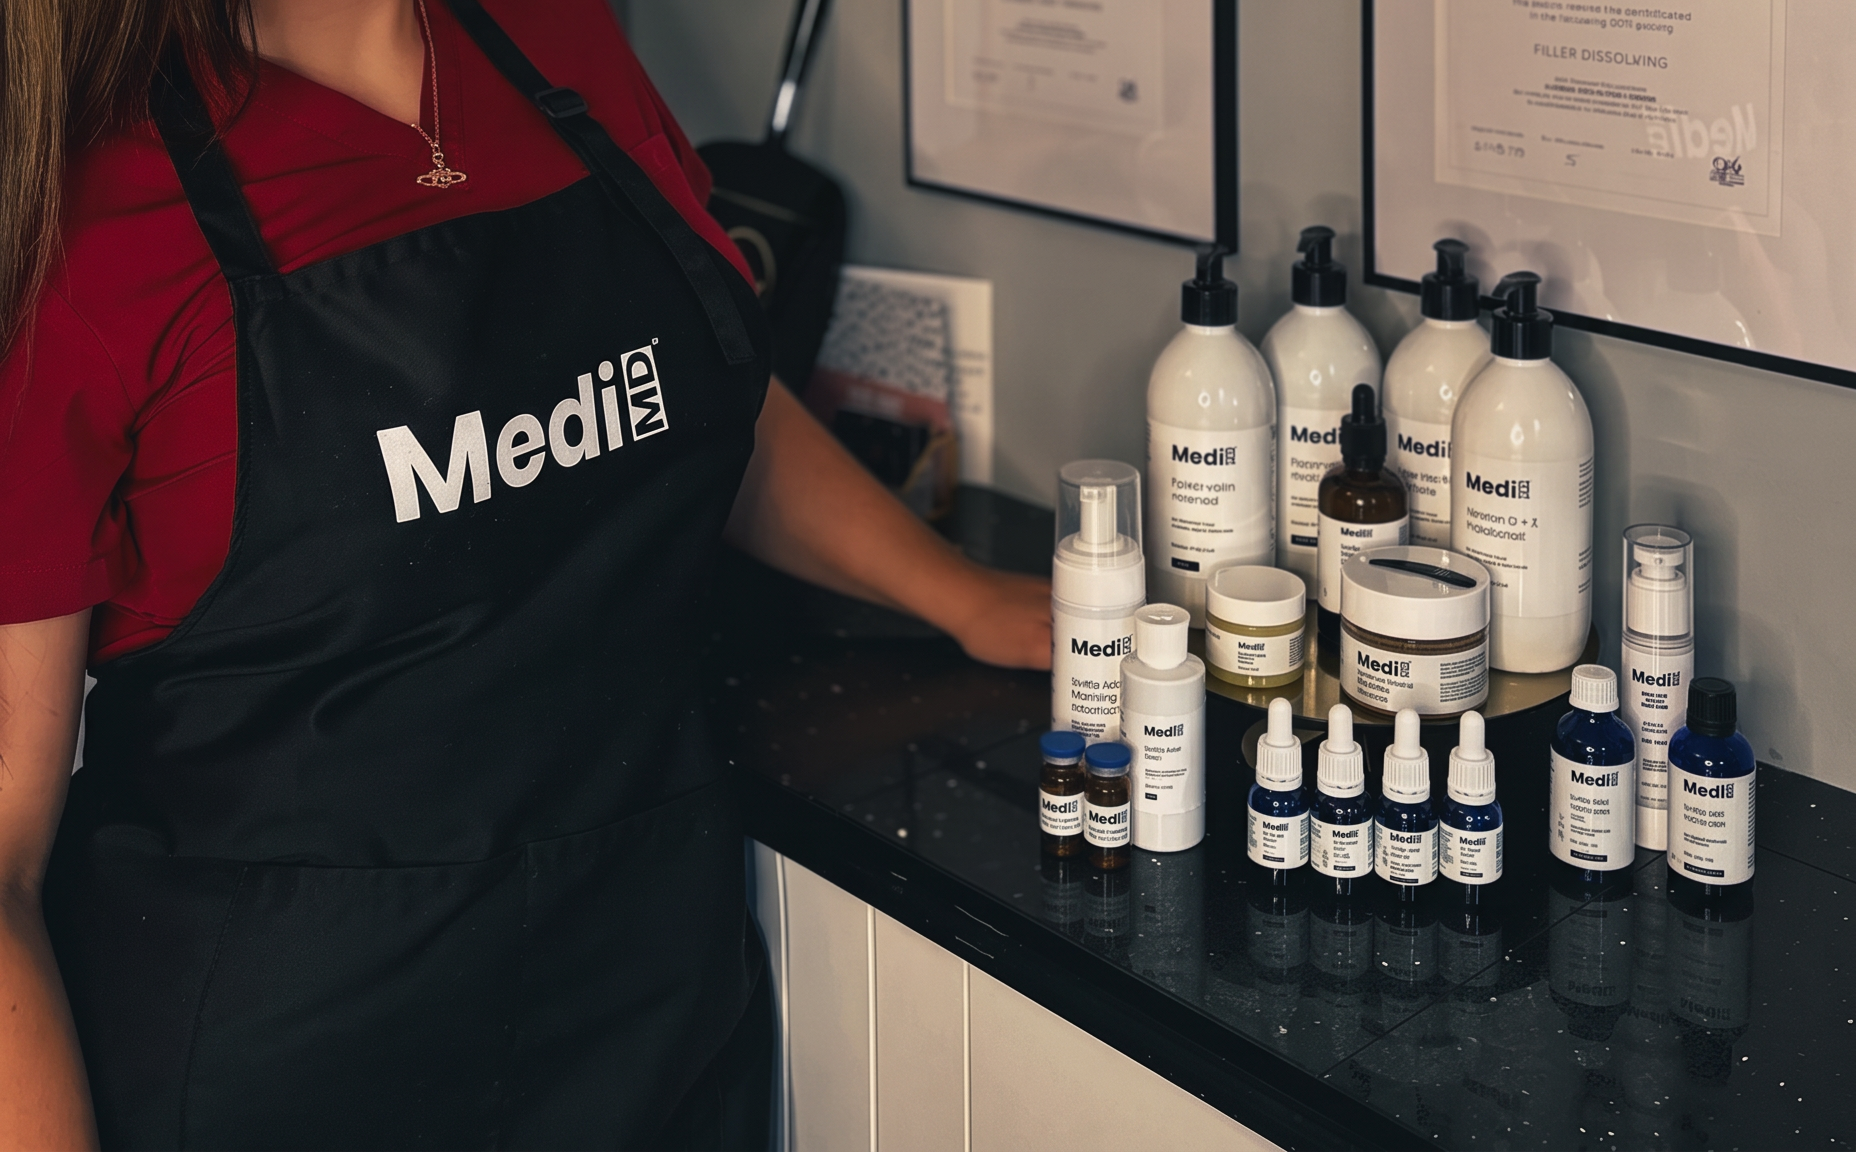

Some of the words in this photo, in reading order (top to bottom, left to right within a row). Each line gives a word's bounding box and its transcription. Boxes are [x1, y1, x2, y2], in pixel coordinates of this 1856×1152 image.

[1533, 43, 1577, 60] FILLER
[376, 359, 624, 524] Medi
[1397, 433, 1446, 458] Medi
[1171, 444, 1225, 466] Medi
[1466, 471, 1517, 500] Medi
[1071, 637, 1122, 657] Medi
[1357, 651, 1399, 677] Medi
[1632, 668, 1672, 687] Medi
